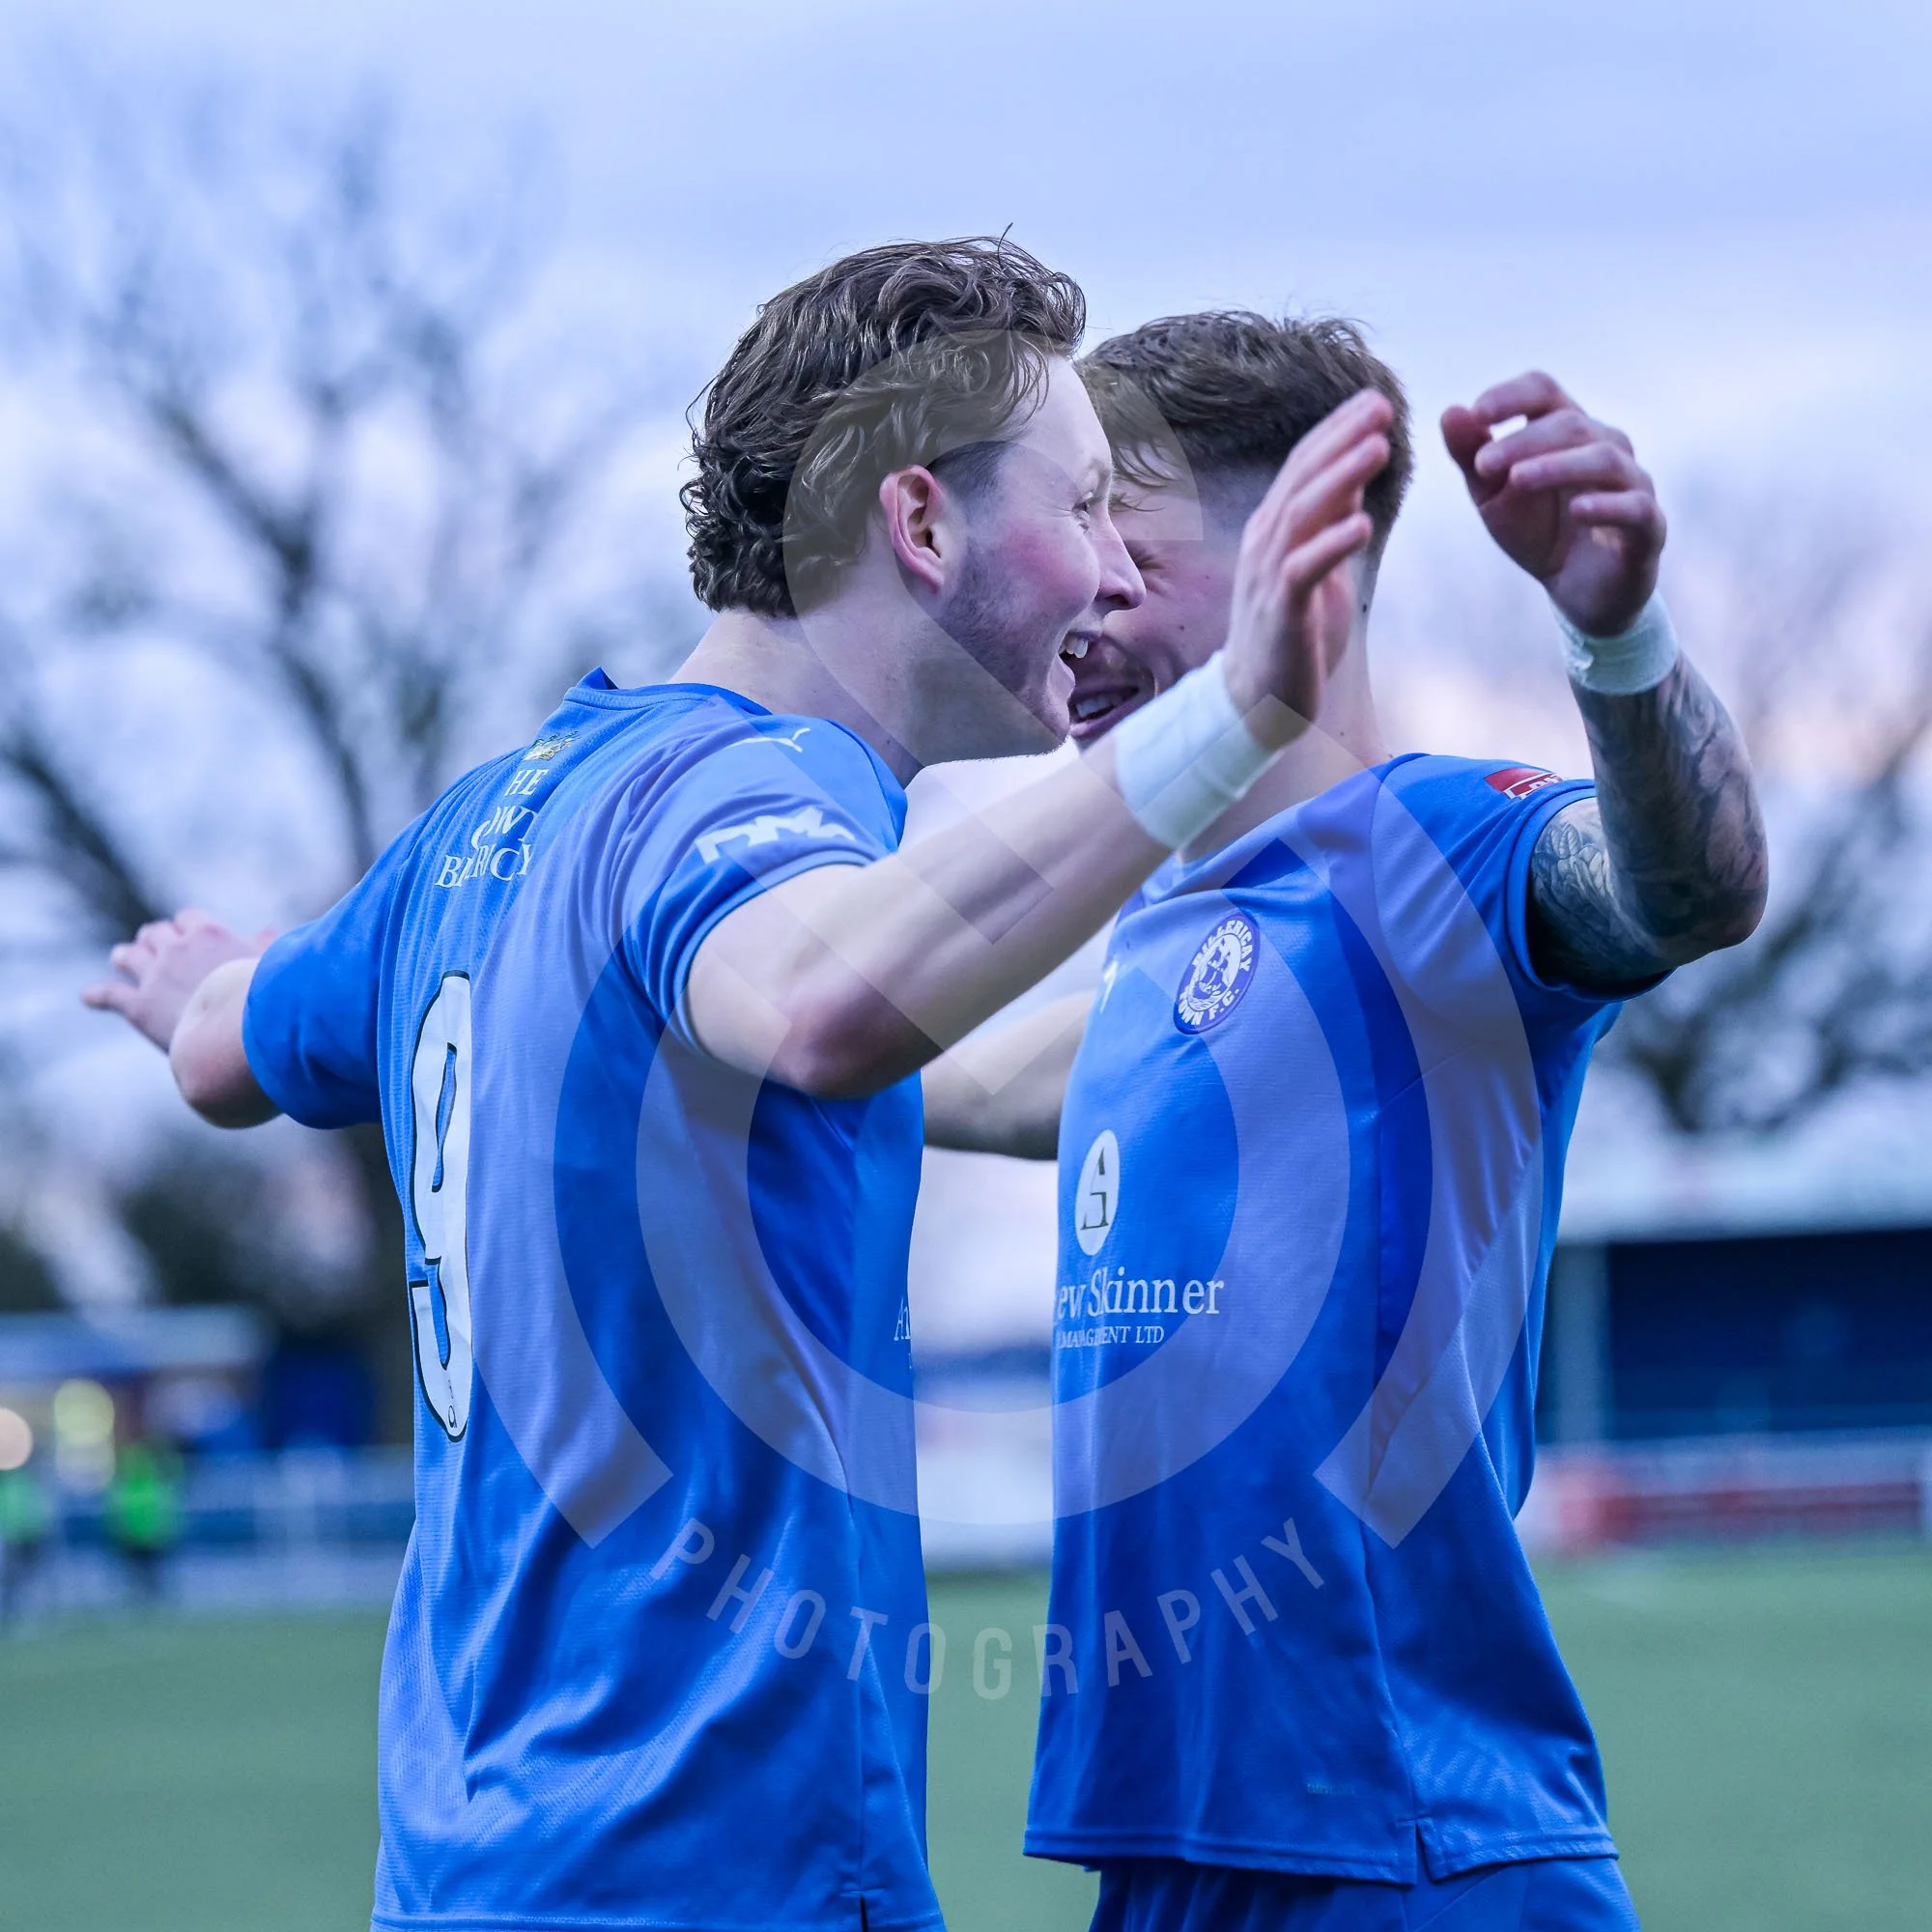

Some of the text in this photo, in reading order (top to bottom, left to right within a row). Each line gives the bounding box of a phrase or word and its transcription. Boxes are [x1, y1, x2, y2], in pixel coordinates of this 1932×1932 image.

[504, 769, 549, 796] HE
[1192, 920, 1253, 971] BILLERICAY
[1179, 986, 1204, 1025] TOWN
[408, 970, 471, 1442] 9
[1088, 1266, 1224, 1316] Skinner
[1135, 1326, 1165, 1344] LTD
